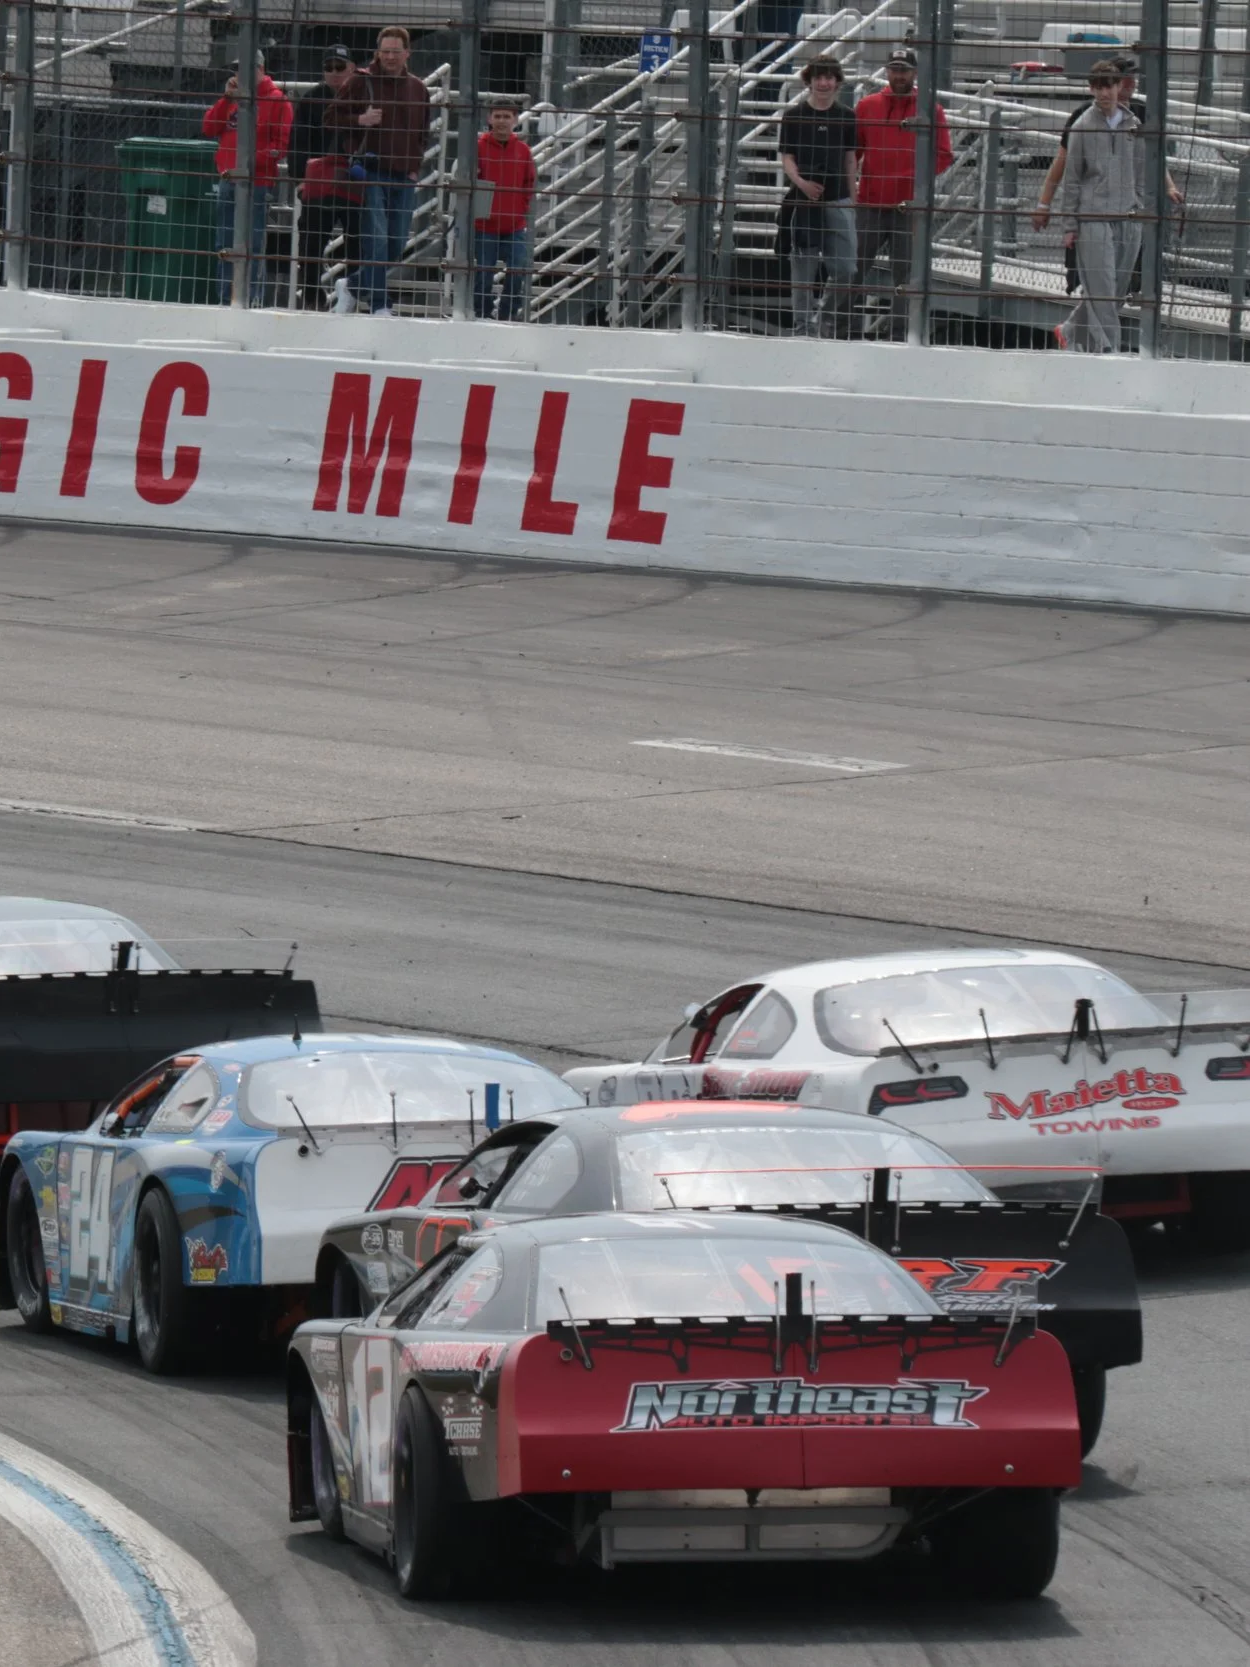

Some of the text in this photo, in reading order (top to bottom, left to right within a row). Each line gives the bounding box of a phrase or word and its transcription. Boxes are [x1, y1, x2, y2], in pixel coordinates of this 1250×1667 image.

[312, 372, 685, 544] MILE
[984, 1067, 1187, 1120] Maietta
[1030, 1116, 1161, 1135] TOWING
[68, 1146, 116, 1286] 24
[616, 1379, 986, 1430] Northeast
